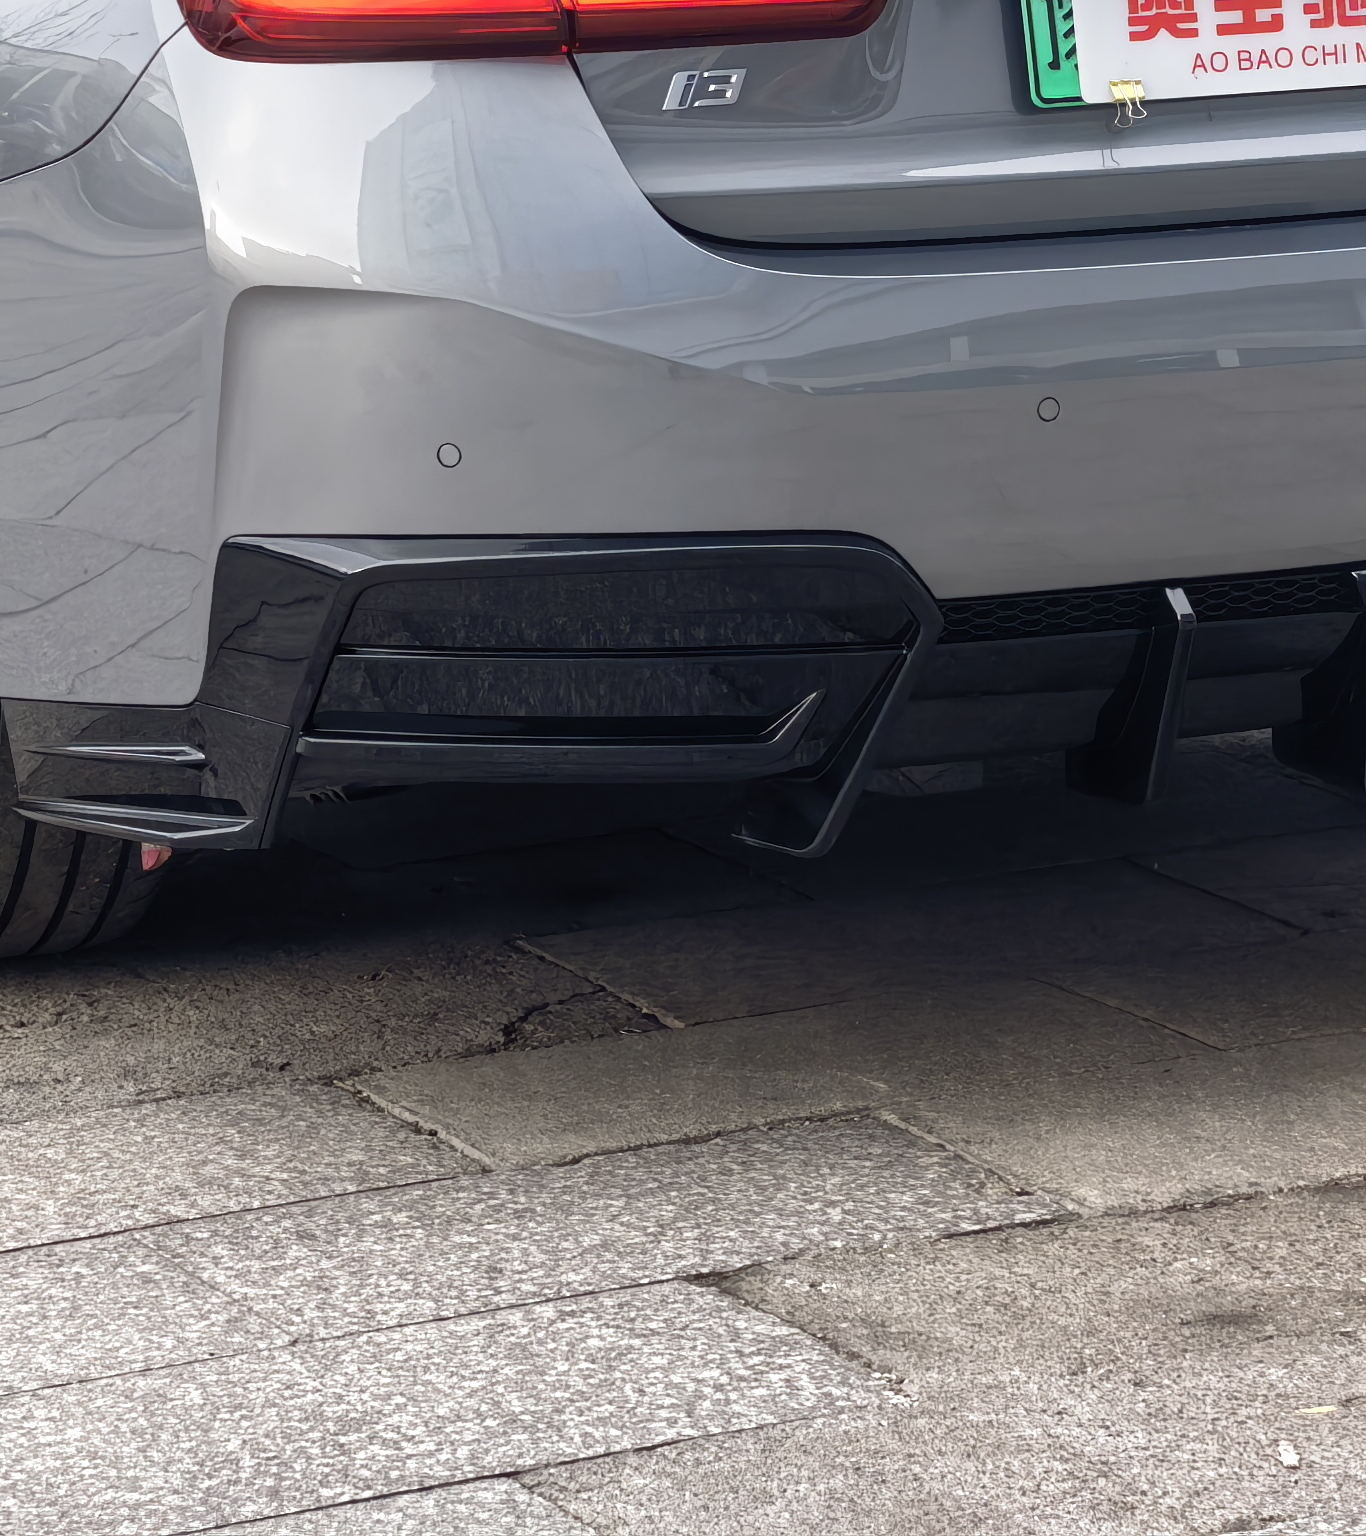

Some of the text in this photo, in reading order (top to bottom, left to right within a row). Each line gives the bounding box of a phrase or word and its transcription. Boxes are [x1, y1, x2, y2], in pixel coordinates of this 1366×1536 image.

[1191, 51, 1230, 75] AO
[1237, 46, 1295, 72] BAO
[1301, 42, 1349, 68] CHI
[661, 67, 748, 111] i3
